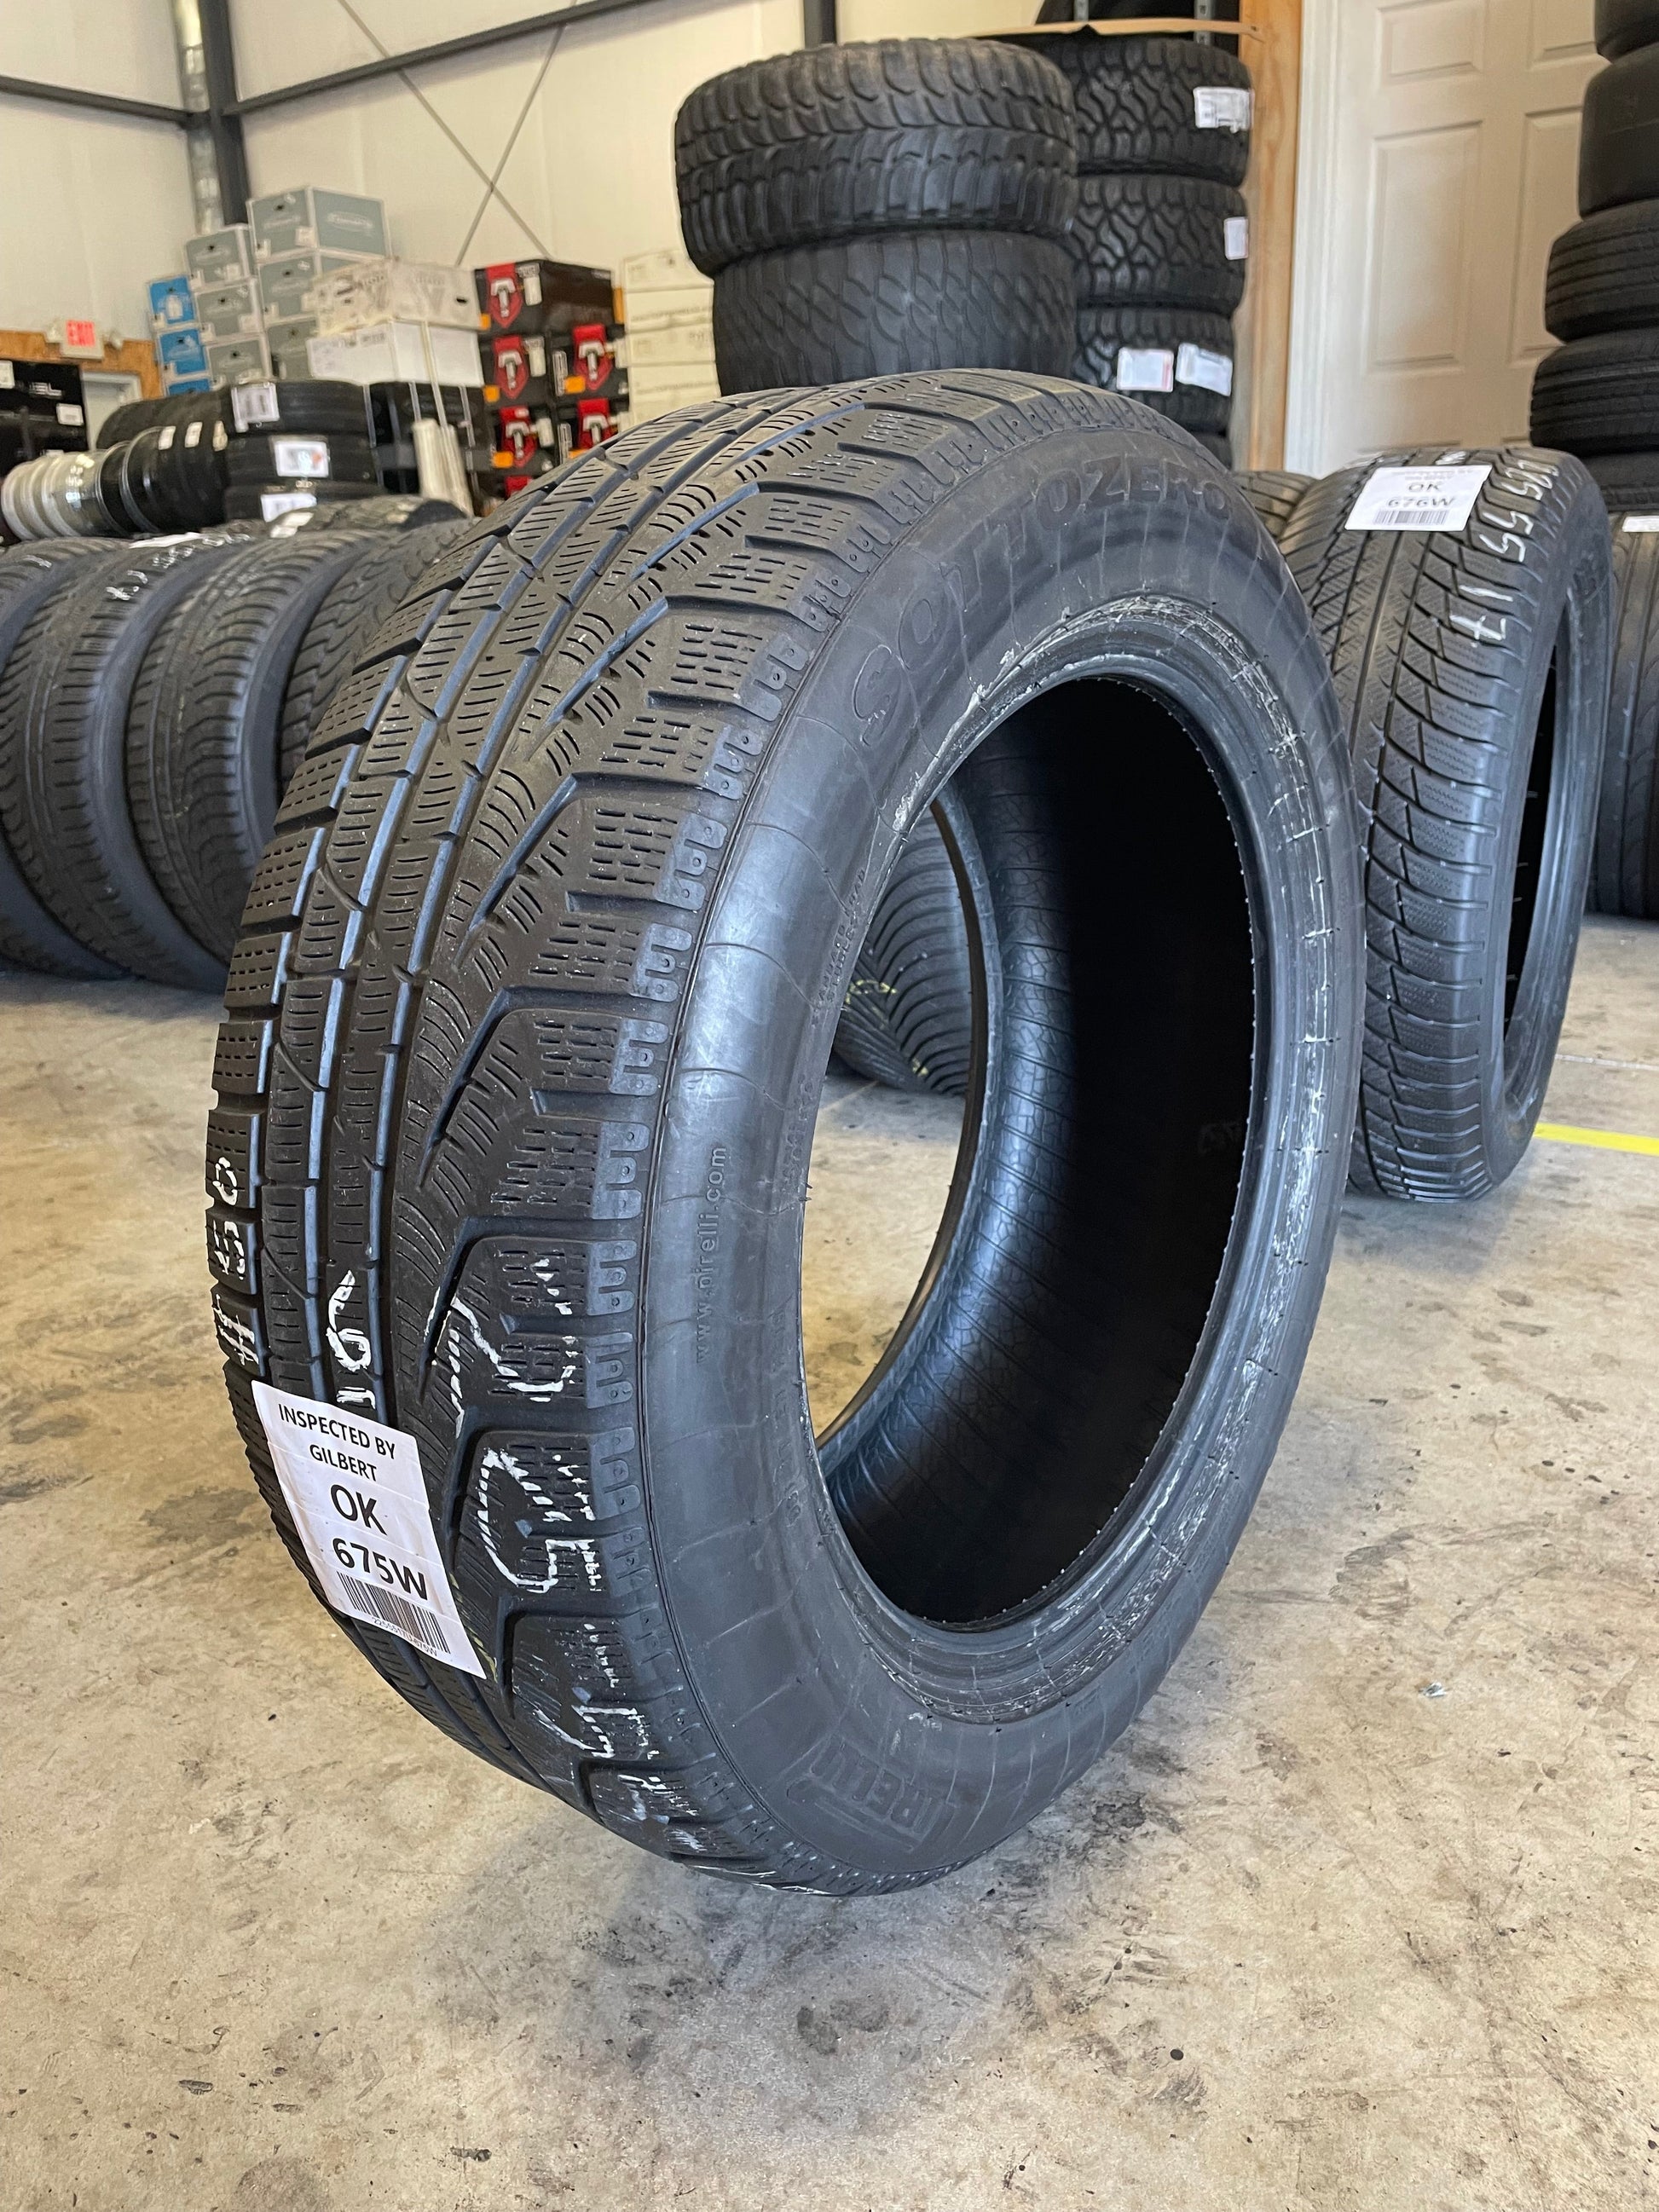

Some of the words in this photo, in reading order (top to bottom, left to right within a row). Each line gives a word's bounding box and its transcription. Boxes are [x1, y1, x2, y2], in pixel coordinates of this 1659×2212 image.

[1408, 482, 1442, 493] OK
[695, 1147, 726, 1364] www.pirelli.com
[279, 1403, 370, 1449] INSPECTED
[375, 1436, 396, 1459] BY
[309, 1445, 377, 1481] GILBERT
[330, 1484, 387, 1535] OK
[332, 1538, 428, 1601] 675W
